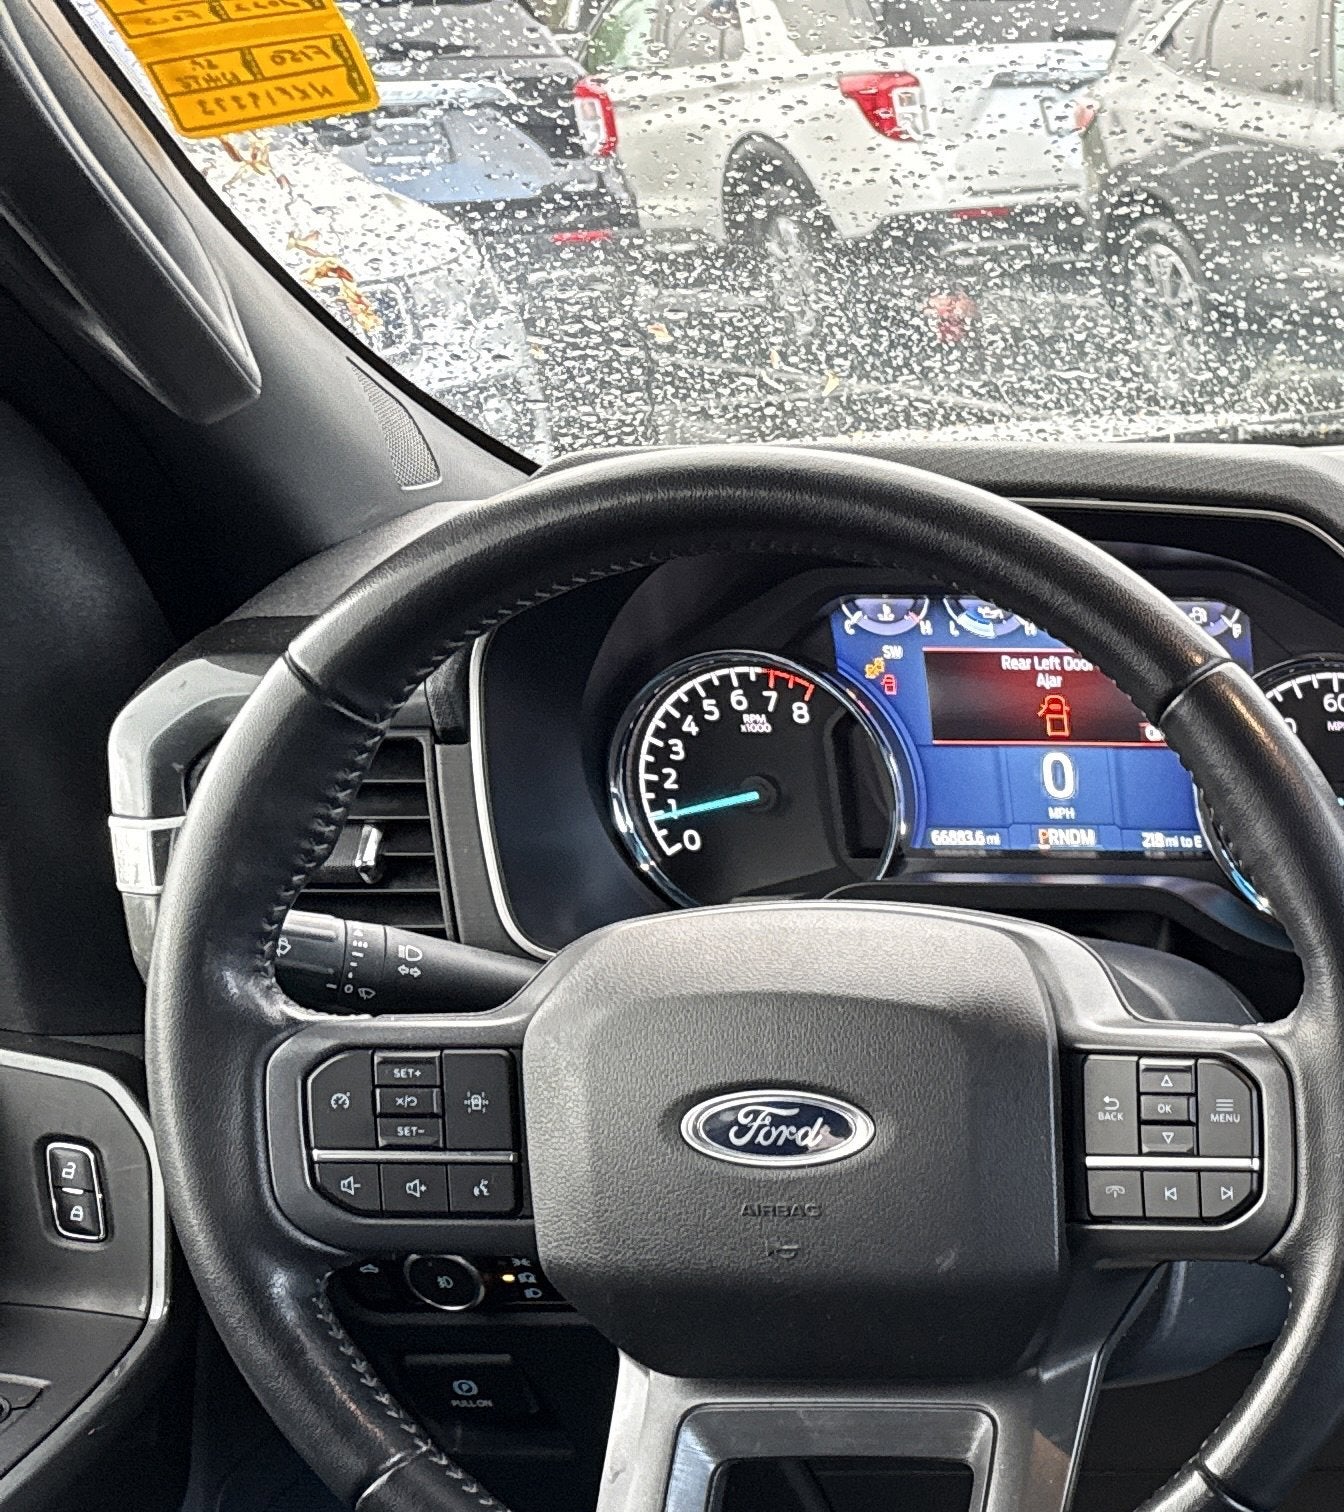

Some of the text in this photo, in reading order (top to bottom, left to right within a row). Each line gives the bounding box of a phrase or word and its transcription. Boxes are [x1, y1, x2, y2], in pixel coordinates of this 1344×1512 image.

[882, 645, 904, 659] SW
[1001, 655, 1031, 670] Rear
[1033, 655, 1061, 670] Left
[1036, 675, 1063, 689] Ajar
[730, 689, 748, 711] 6
[762, 691, 778, 712] 7
[703, 699, 720, 721] 5
[742, 713, 767, 724] RPM
[792, 702, 810, 724] 8
[682, 715, 699, 736] 4
[668, 739, 686, 760] 3
[662, 768, 679, 789] 2
[1042, 751, 1077, 799] 0
[1048, 806, 1075, 820] MPH
[683, 829, 701, 851] 0
[1165, 834, 1179, 847] mi
[1180, 834, 1193, 847] to
[1098, 1112, 1124, 1121] BACK
[1157, 1104, 1173, 1114] OK
[1210, 1113, 1240, 1123] MENU
[729, 1105, 823, 1148] Ford
[741, 1203, 823, 1218] AIRBAG
